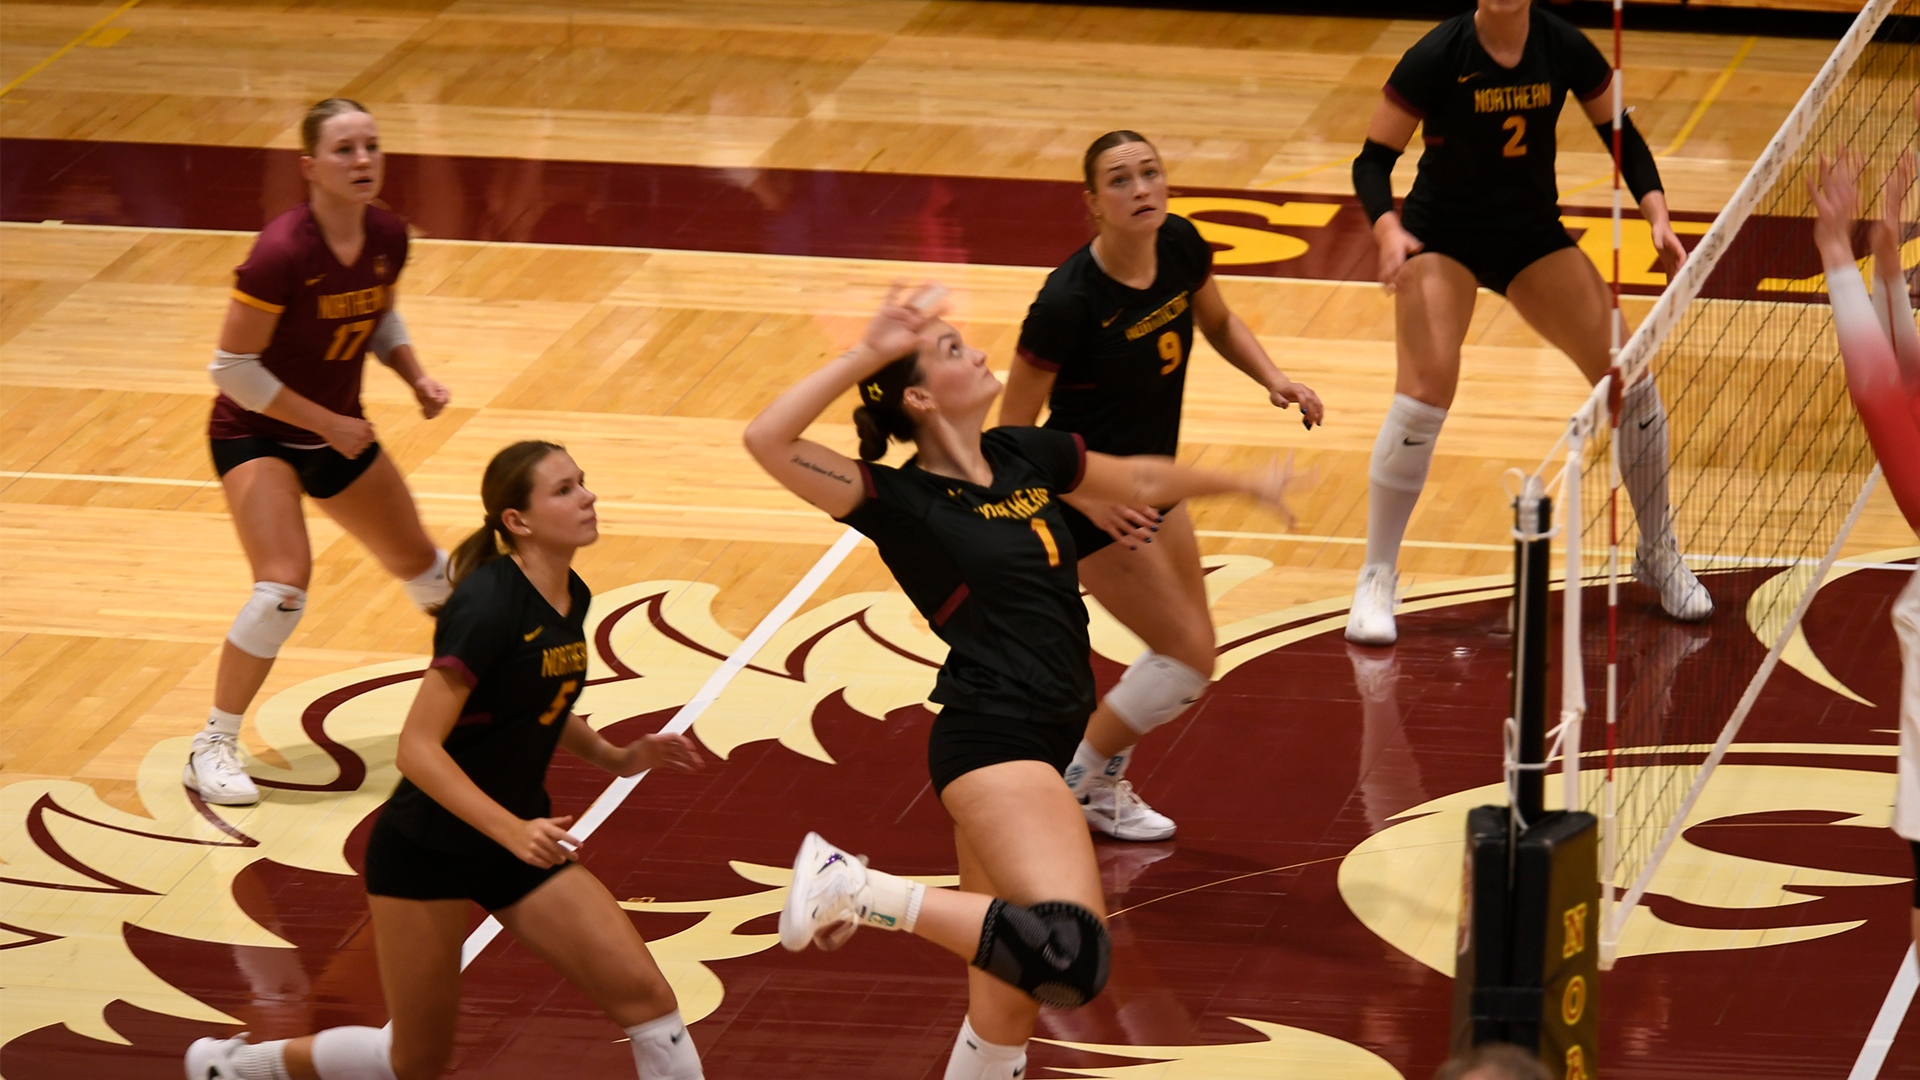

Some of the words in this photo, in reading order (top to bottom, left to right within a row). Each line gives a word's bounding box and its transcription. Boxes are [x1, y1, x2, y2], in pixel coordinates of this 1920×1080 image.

[1474, 82, 1551, 113] NORTHERN
[1502, 115, 1527, 157] 2
[323, 319, 375, 361] 17
[1157, 330, 1183, 376] 9
[1030, 517, 1060, 567] 1
[538, 680, 578, 726] 5
